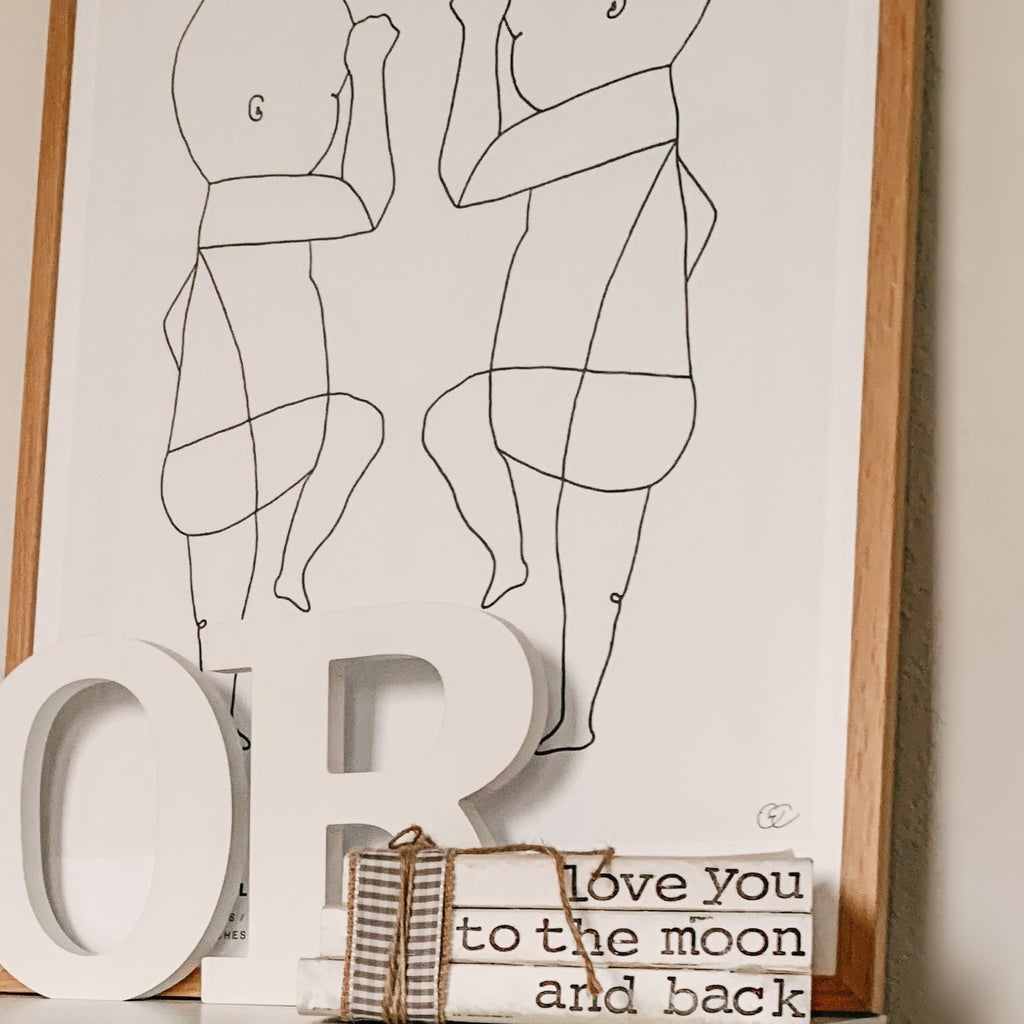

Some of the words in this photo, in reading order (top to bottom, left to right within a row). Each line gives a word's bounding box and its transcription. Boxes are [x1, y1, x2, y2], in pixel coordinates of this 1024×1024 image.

[563, 865, 687, 903] love
[703, 867, 804, 905] you
[455, 917, 521, 952] to
[535, 917, 639, 957] the
[660, 926, 807, 957] moon
[535, 975, 637, 1015] and
[666, 976, 806, 1018] back
